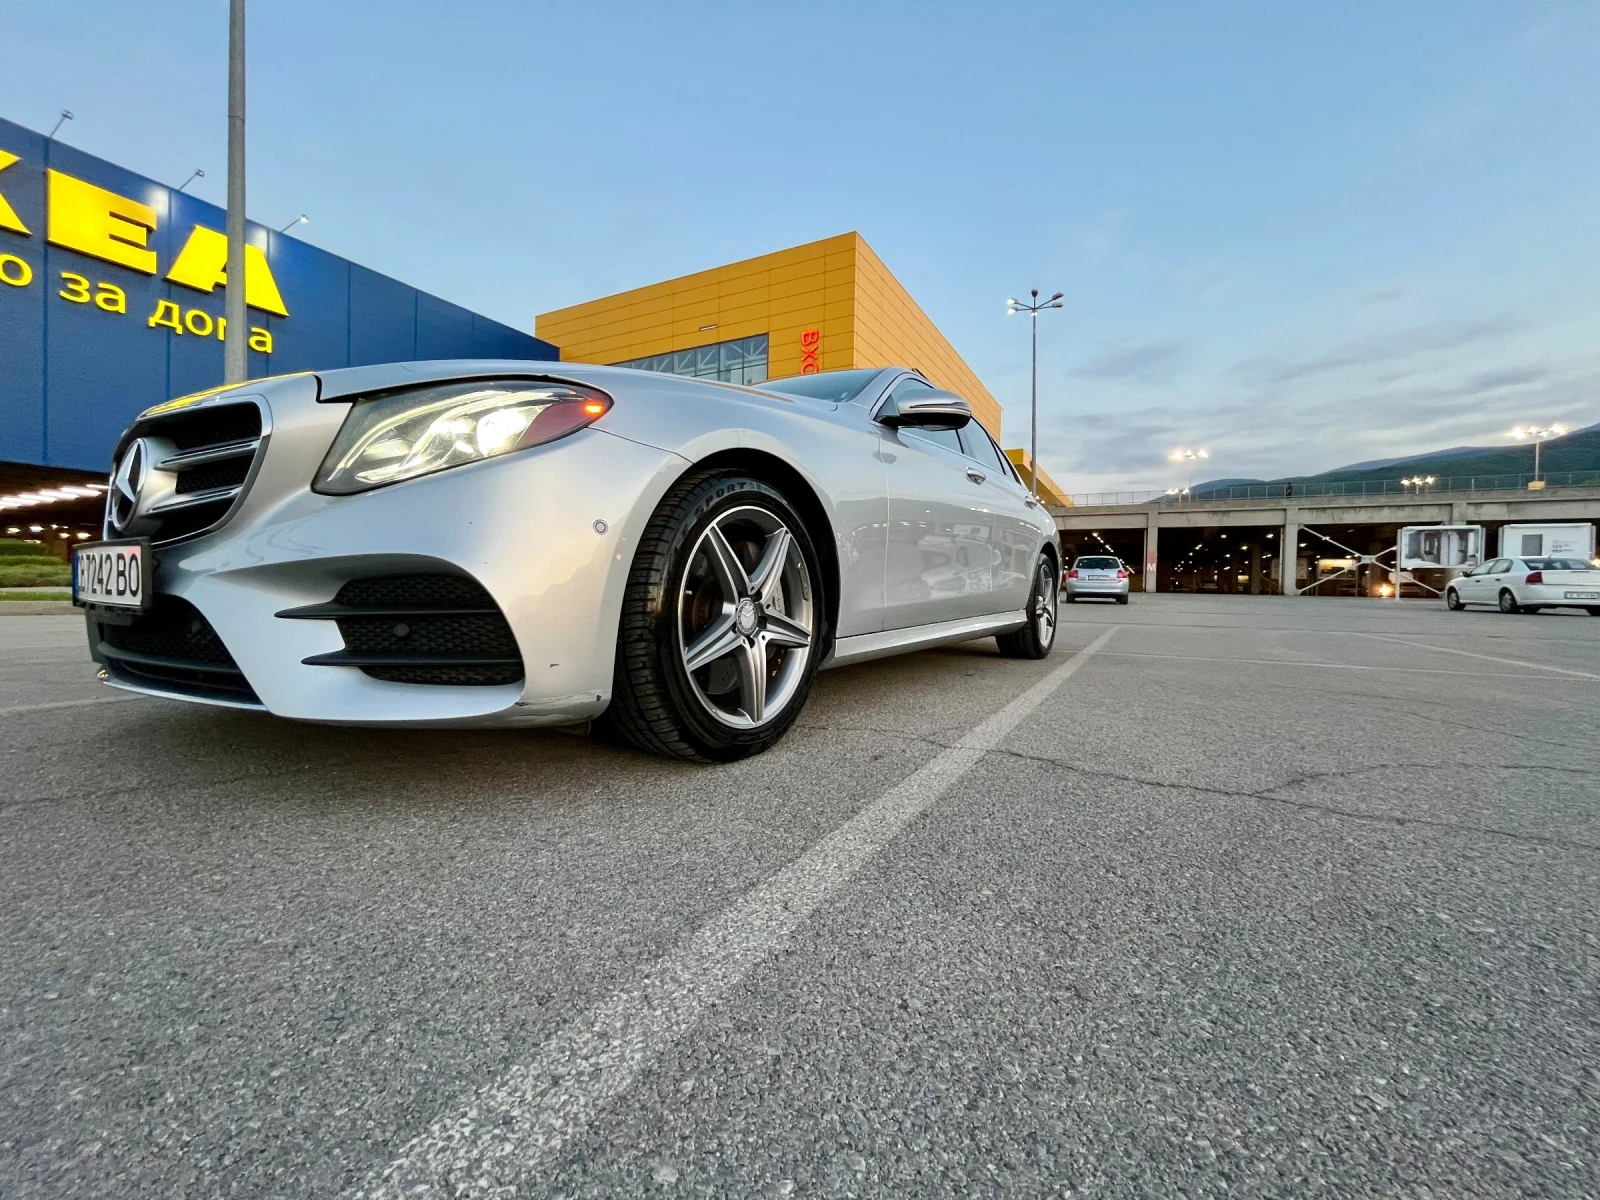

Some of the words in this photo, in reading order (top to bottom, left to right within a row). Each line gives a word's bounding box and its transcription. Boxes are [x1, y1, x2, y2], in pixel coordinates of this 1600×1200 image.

[0, 149, 290, 317] EA
[59, 271, 126, 314] за
[148, 299, 273, 354] доа
[693, 481, 747, 518] SPORT
